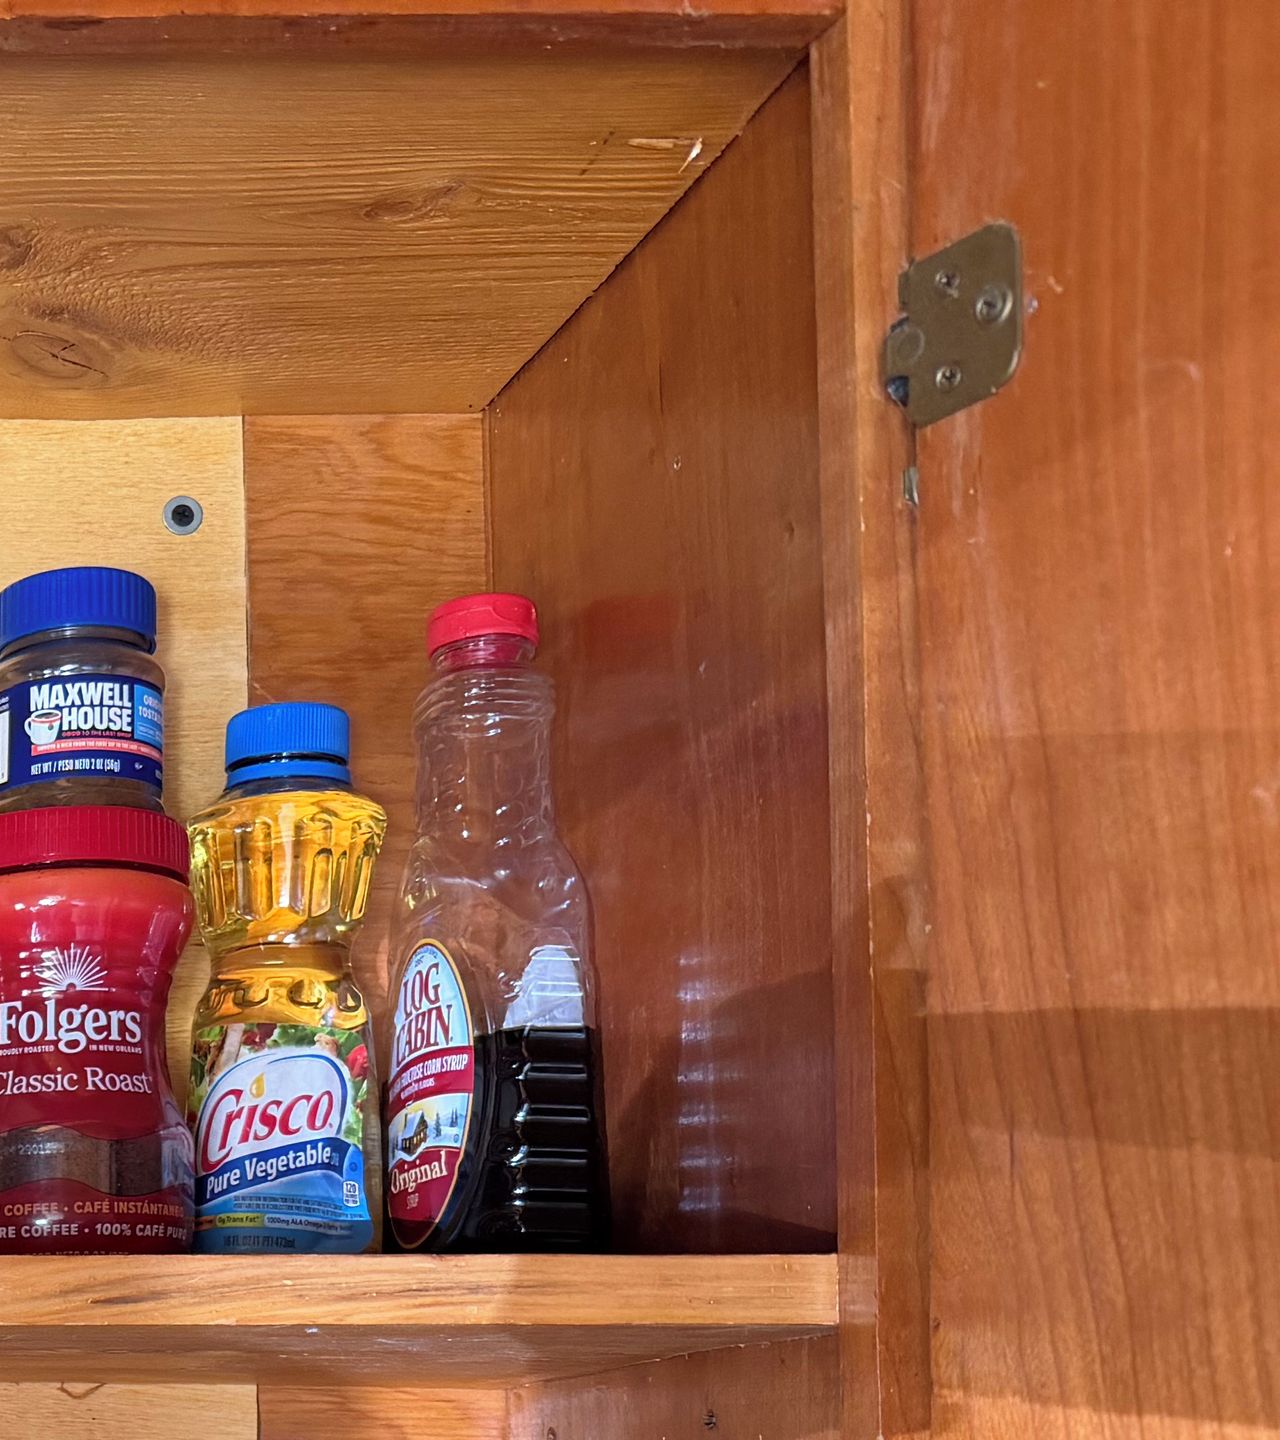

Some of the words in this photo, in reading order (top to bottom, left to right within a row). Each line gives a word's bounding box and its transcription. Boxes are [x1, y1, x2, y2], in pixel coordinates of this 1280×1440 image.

[29, 682, 132, 712] MAXWELL
[61, 707, 133, 732] HOUSE
[30, 763, 41, 776] NET
[57, 760, 73, 771] PESO
[74, 759, 90, 770] NETO
[91, 759, 95, 770] 2
[96, 758, 104, 769] OZ
[402, 962, 441, 1018] LOG
[23, 1045, 55, 1054] ROASTED
[115, 1045, 142, 1055] ORLEANS
[396, 1004, 453, 1069] CABIN
[441, 1053, 468, 1073] SYRUP
[84, 1067, 153, 1094] Roast
[200, 1087, 335, 1174] Crisco
[206, 1167, 241, 1200] Pure
[244, 1141, 332, 1182] Vegetable
[390, 1149, 449, 1194] Original
[3, 1201, 59, 1217] COFFEE
[73, 1198, 111, 1214] CAFÉ
[20, 1223, 79, 1238] COFFEE
[94, 1222, 132, 1237] 100%
[135, 1222, 165, 1237] CAFÉ
